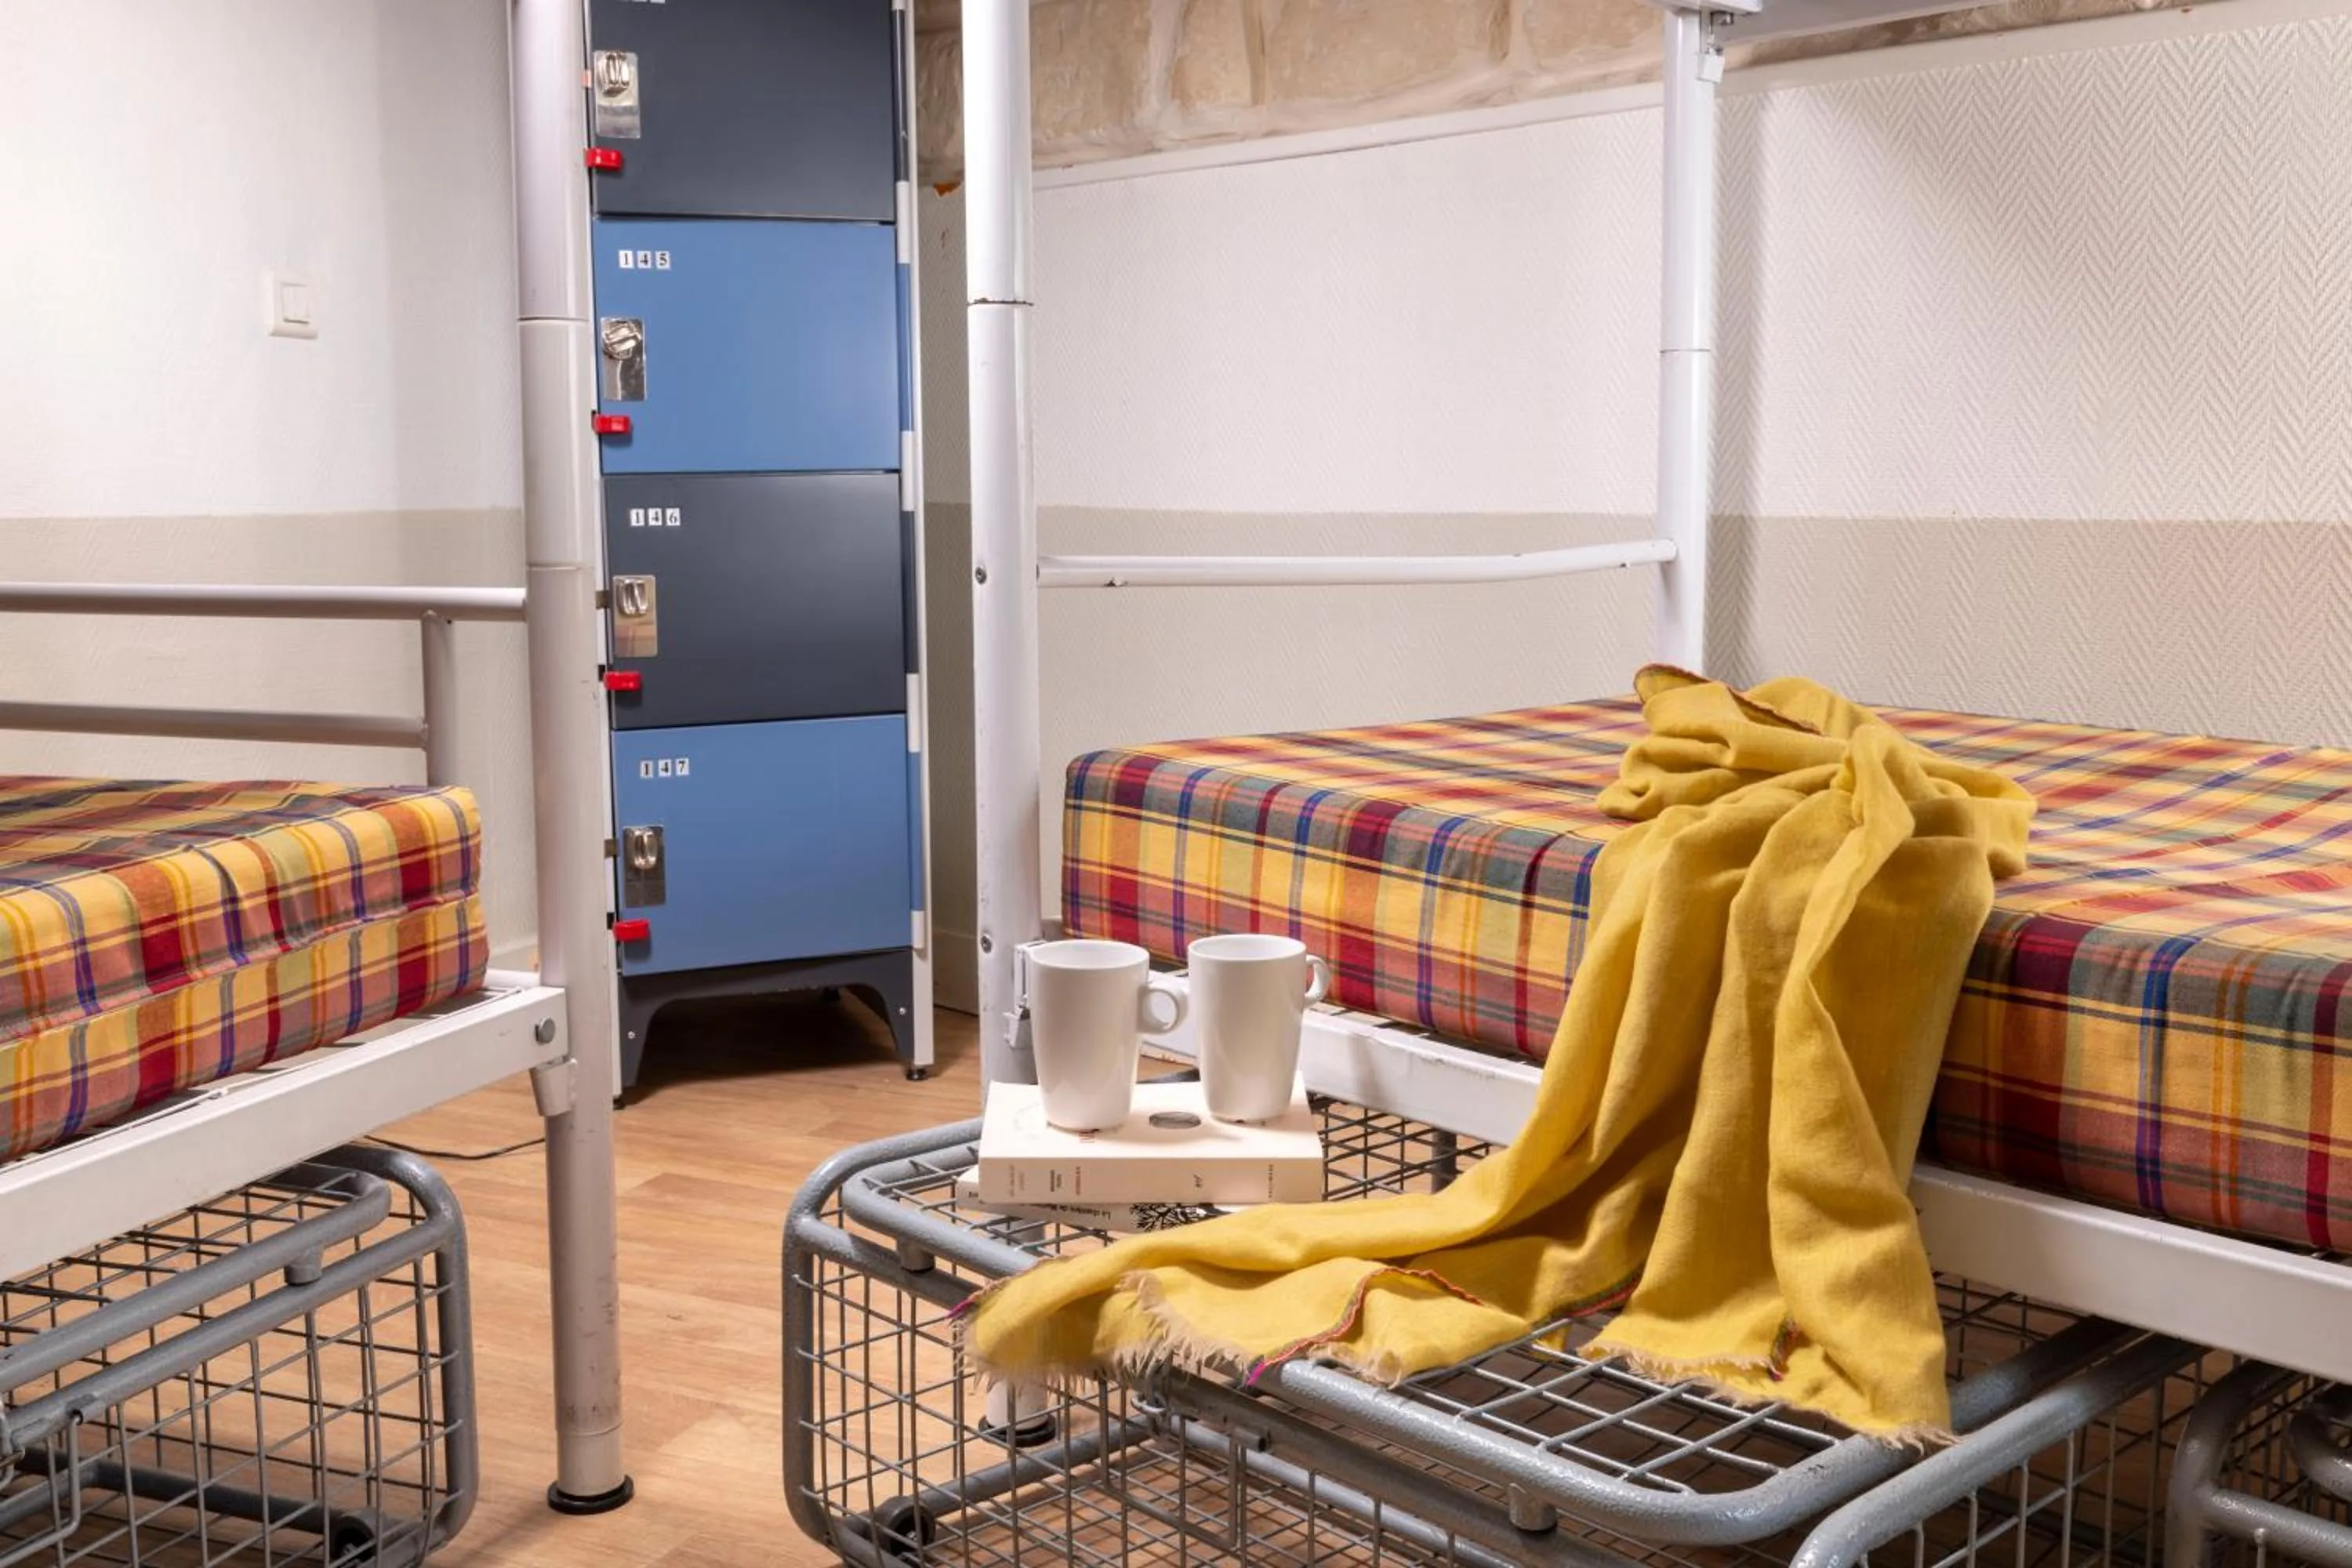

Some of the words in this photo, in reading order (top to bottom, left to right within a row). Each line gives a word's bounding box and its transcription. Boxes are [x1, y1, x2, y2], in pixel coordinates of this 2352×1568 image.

[623, 252, 668, 267] 145
[635, 510, 679, 524] 146
[644, 759, 687, 775] 147
